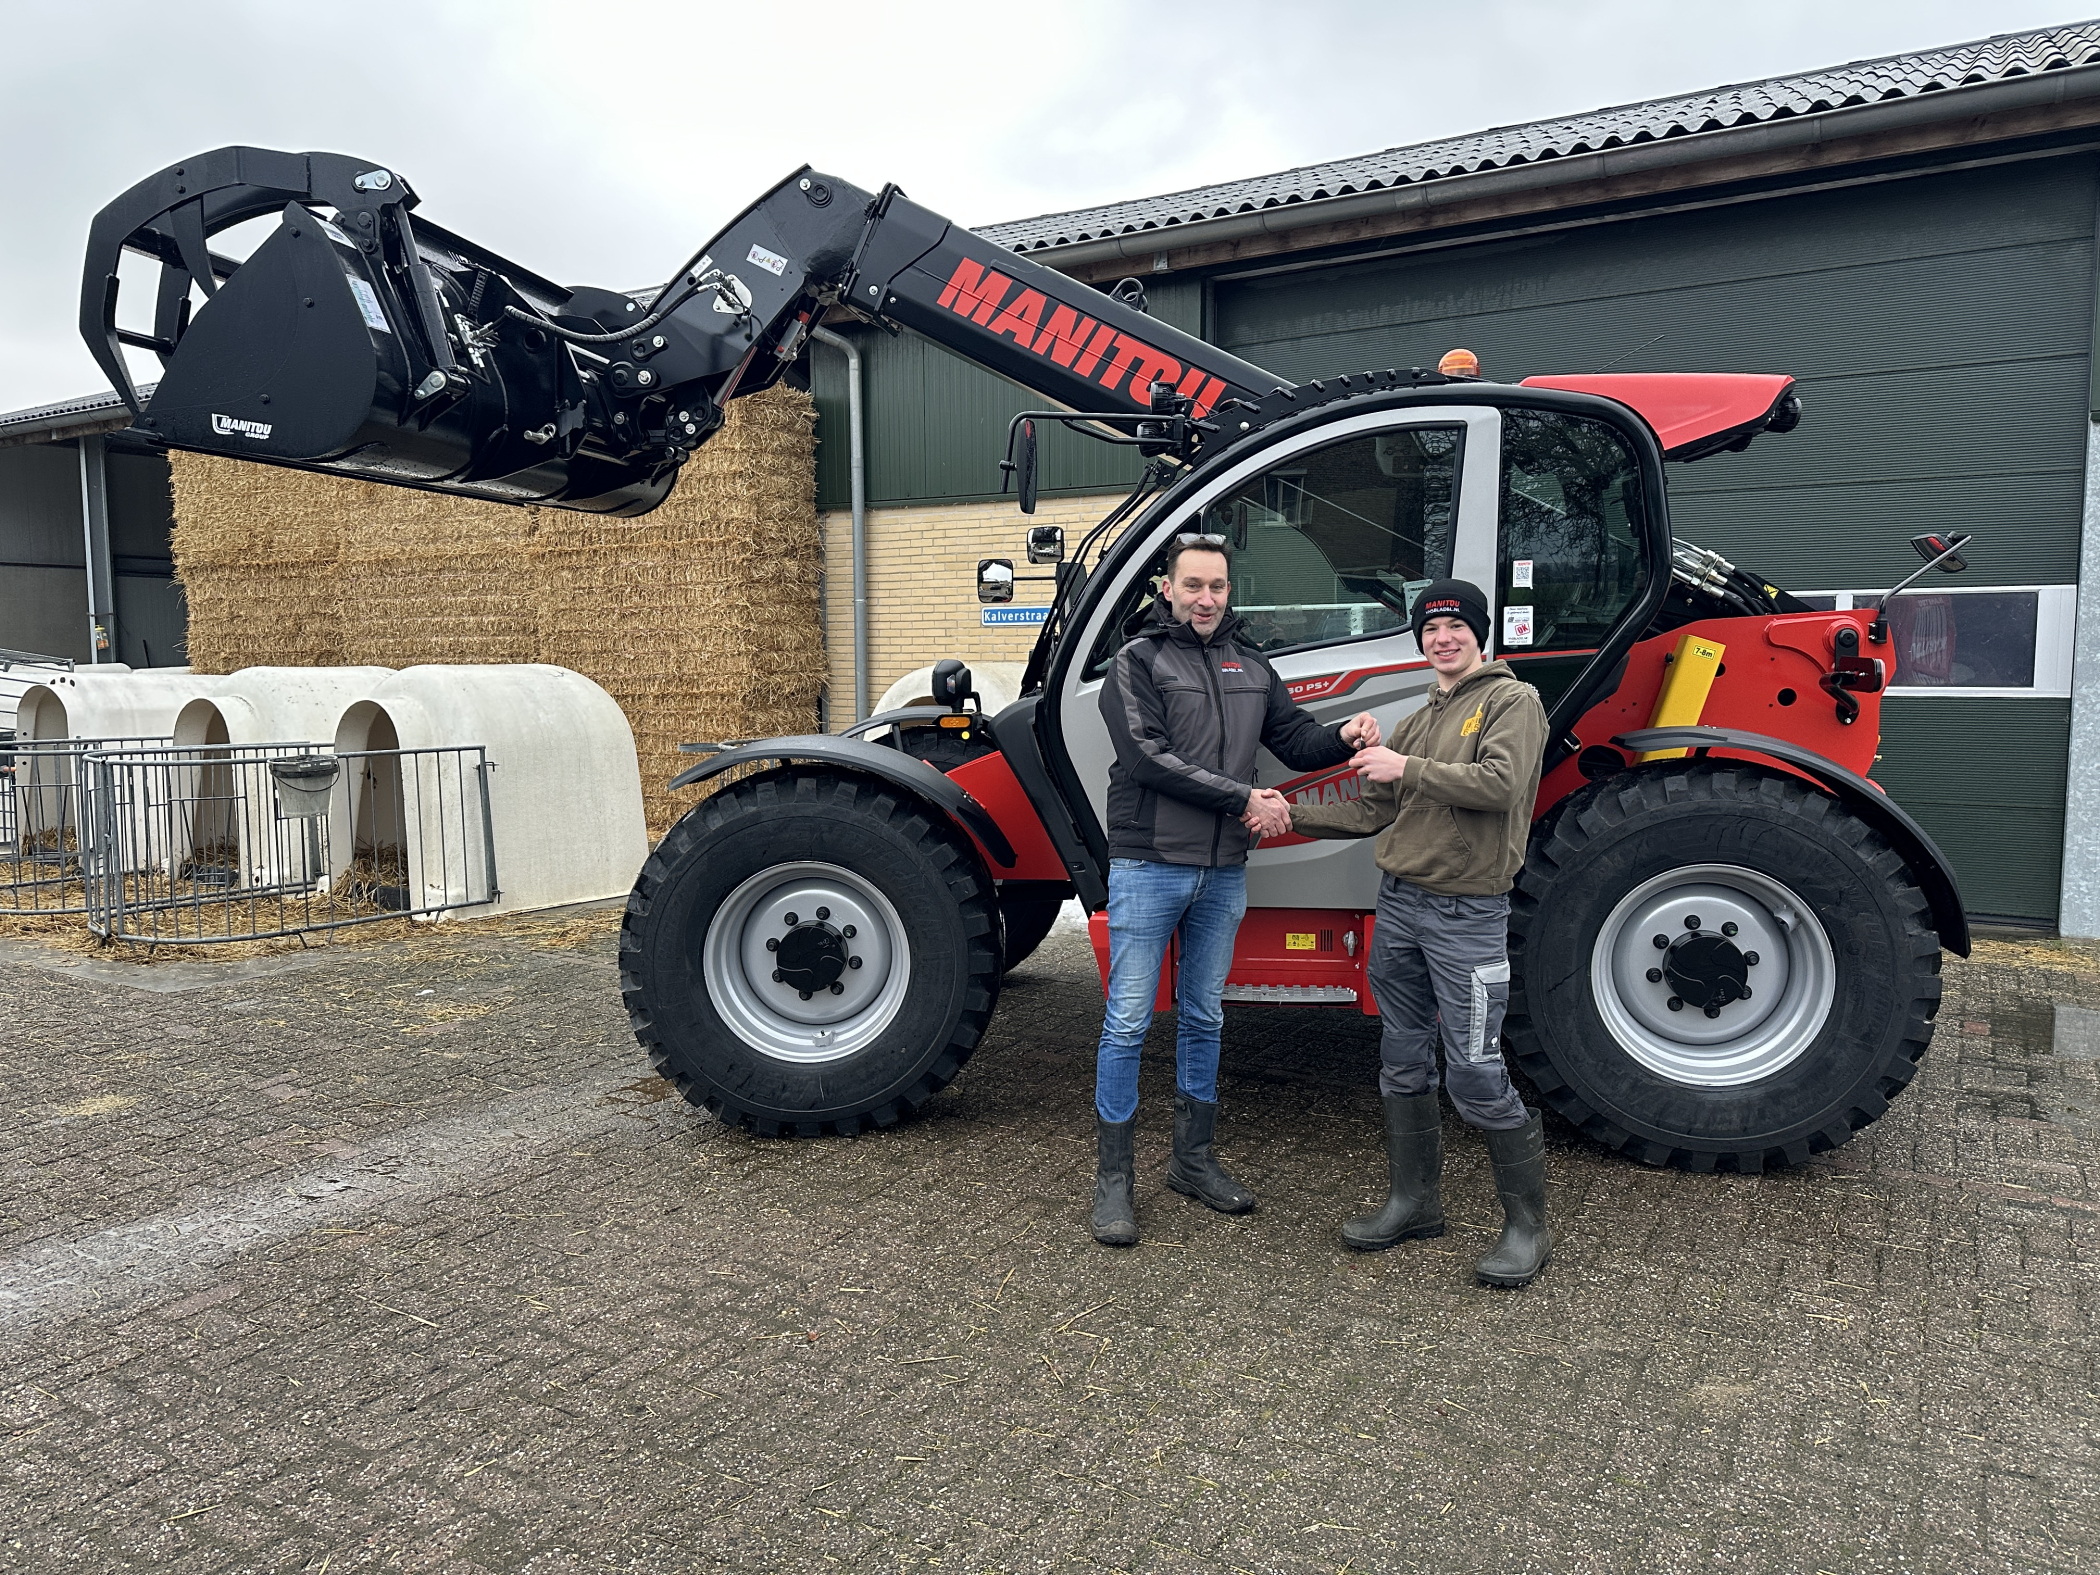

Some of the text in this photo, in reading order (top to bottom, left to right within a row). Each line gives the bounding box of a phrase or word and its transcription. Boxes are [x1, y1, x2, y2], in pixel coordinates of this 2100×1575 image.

[220, 418, 272, 434] MANITOU
[1425, 599, 1461, 610] MANITOU
[984, 611, 1048, 621] Kalverstraa
[1517, 624, 1528, 633] OK
[1695, 647, 1713, 657] 7-8m
[1306, 680, 1330, 692] PS+
